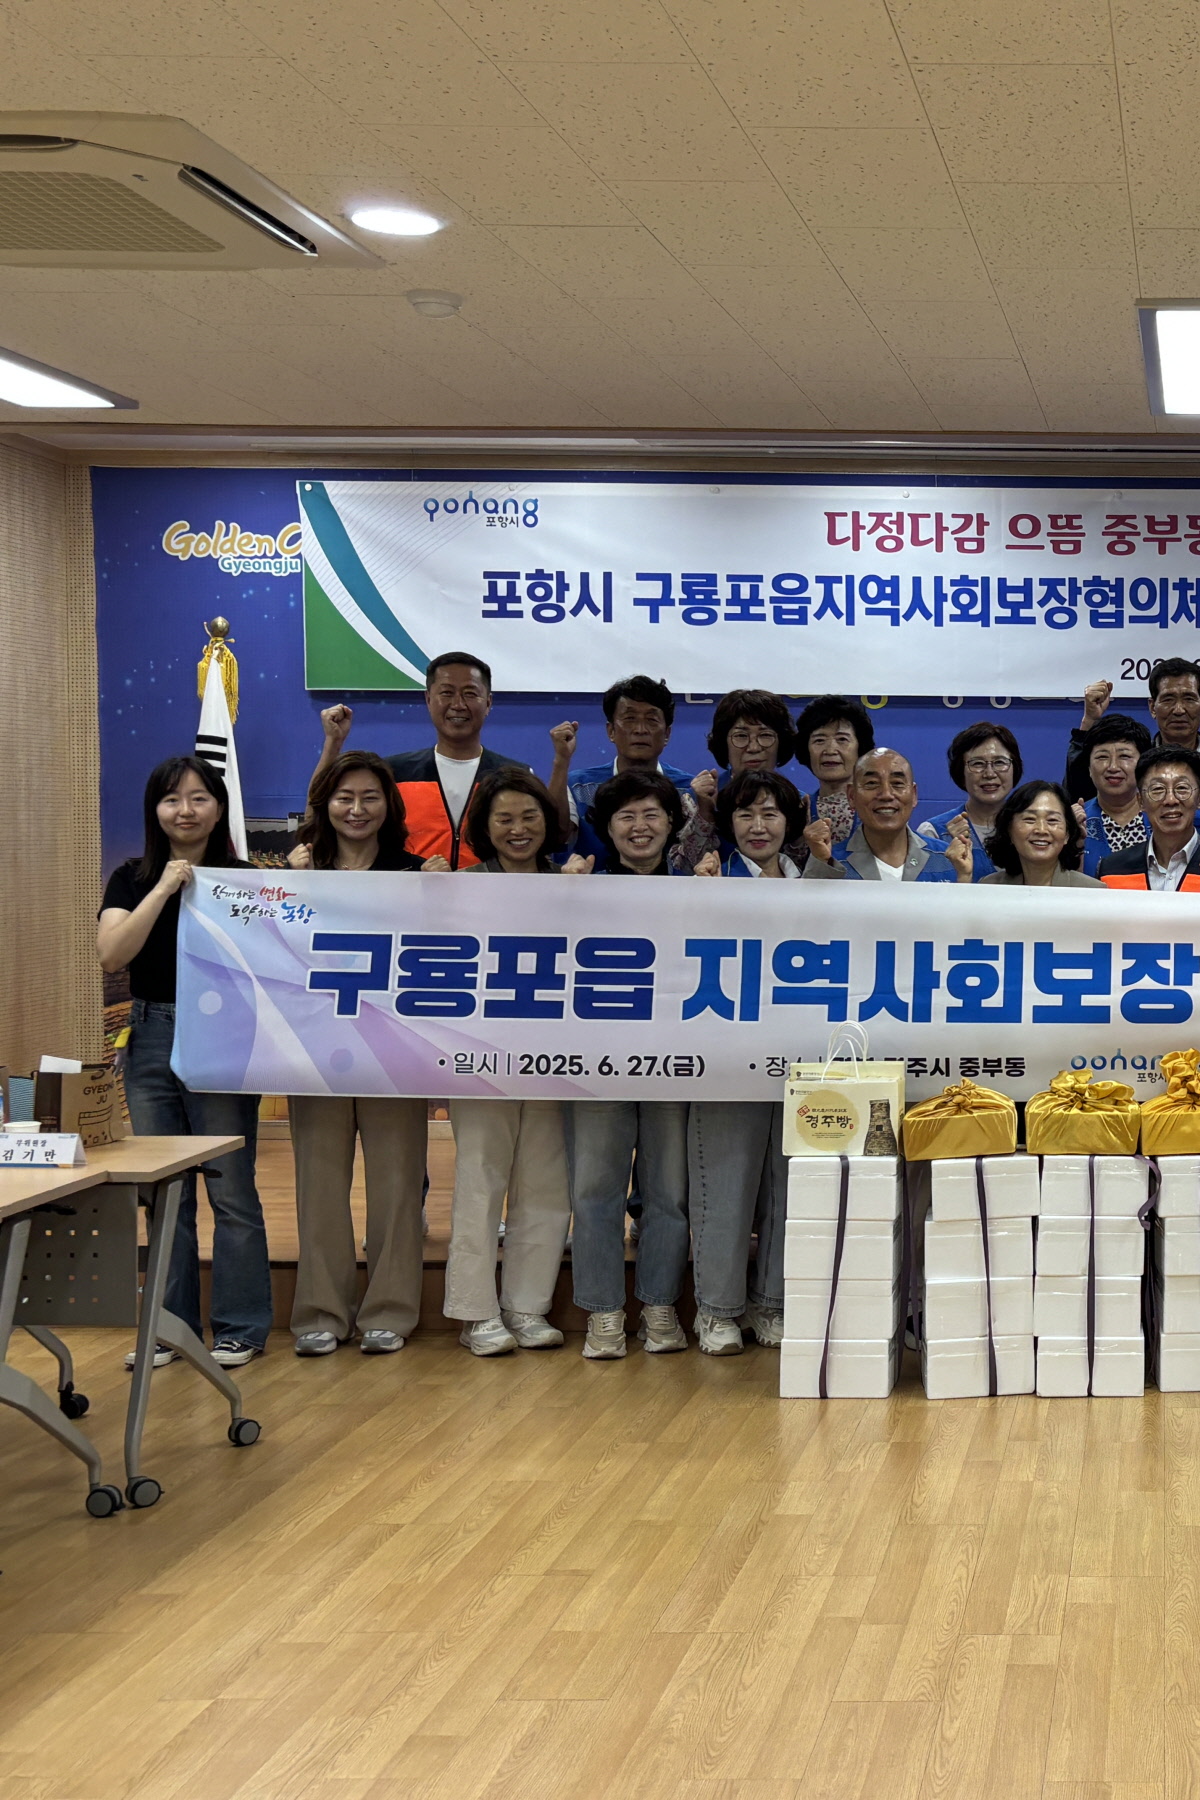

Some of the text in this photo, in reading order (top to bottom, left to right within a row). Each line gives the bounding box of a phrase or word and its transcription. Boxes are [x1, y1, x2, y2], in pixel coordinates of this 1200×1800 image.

[424, 491, 538, 528] pohang
[486, 516, 519, 528] 포항시
[824, 511, 990, 554] 다정다감
[1006, 514, 1086, 555] 으뜸
[164, 522, 273, 558] Golden
[220, 558, 299, 573] Gyeongju
[482, 569, 612, 623] 포항시
[212, 885, 297, 901] 함께하는 변화
[230, 902, 317, 926] 도약하는 포항
[310, 932, 656, 1020] 구룡포읍
[454, 1053, 705, 1078] 일시 2025. 6. 27.(금)
[959, 1057, 1026, 1078] 중부동
[805, 1115, 852, 1129] 경주빵
